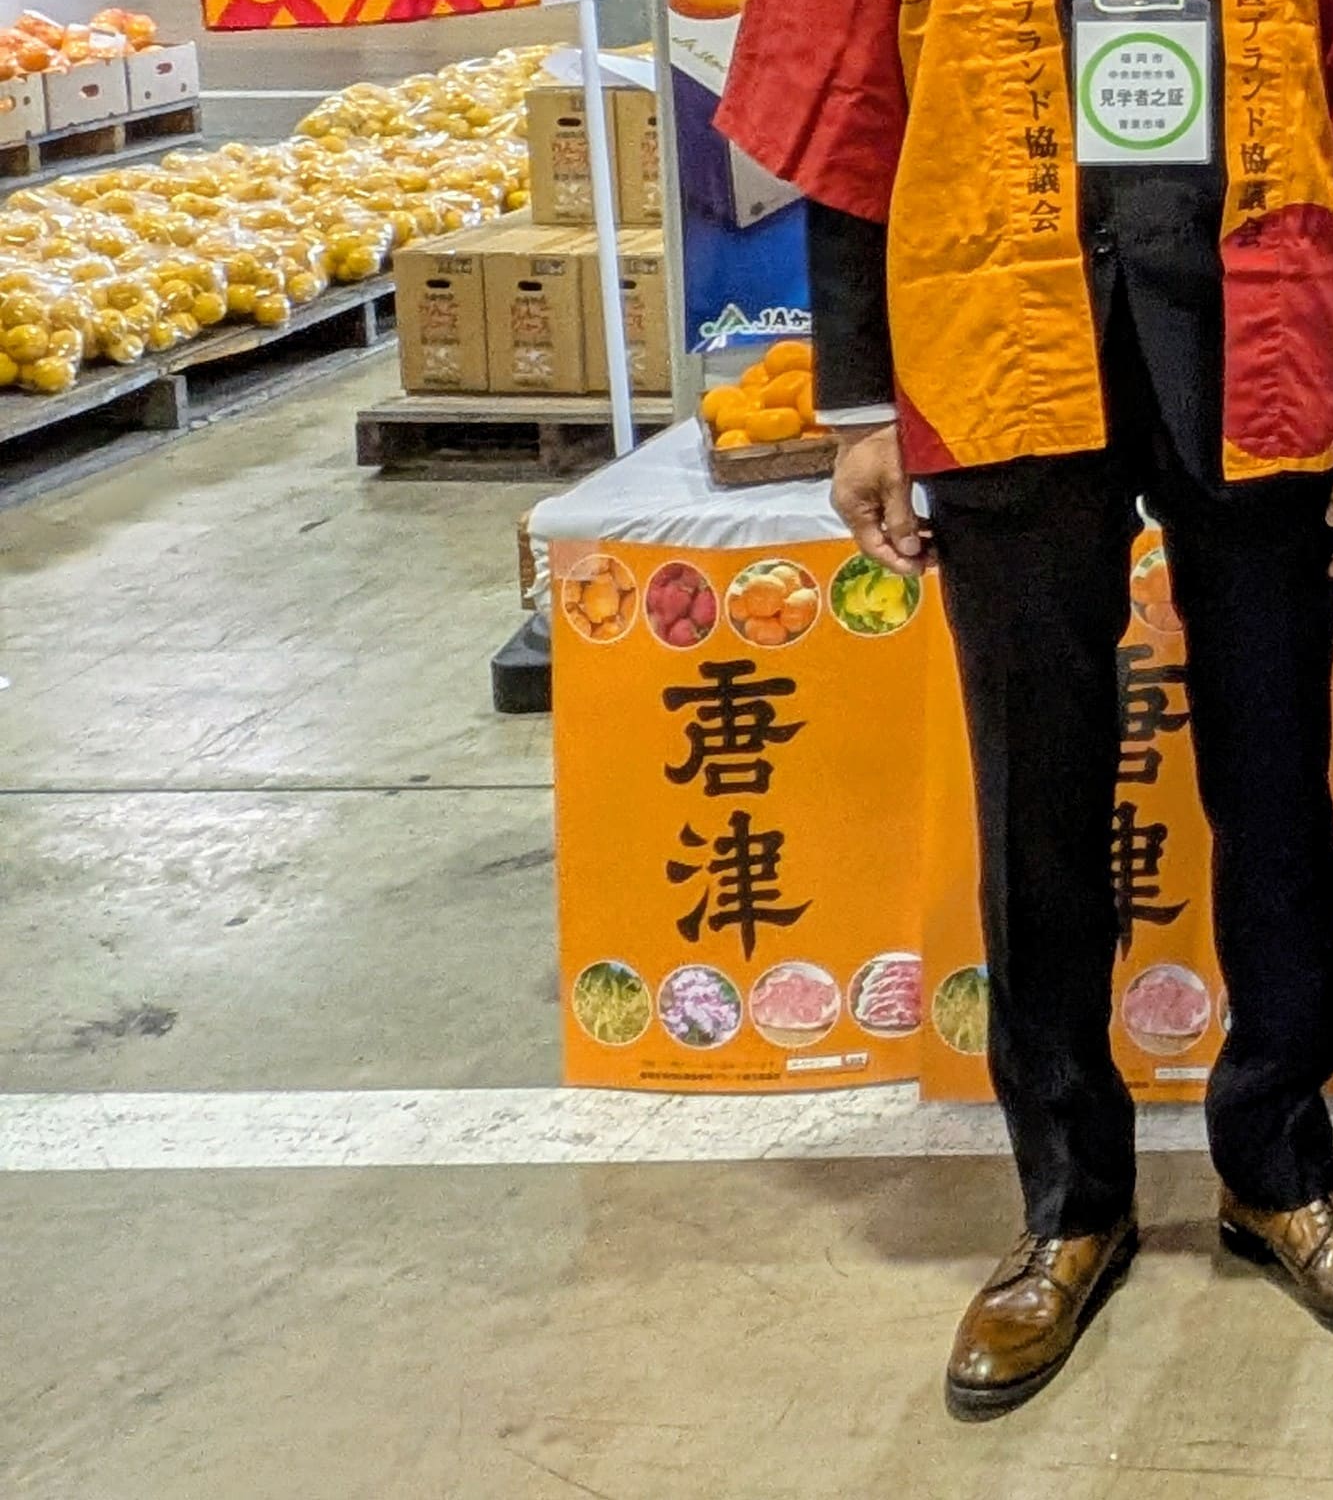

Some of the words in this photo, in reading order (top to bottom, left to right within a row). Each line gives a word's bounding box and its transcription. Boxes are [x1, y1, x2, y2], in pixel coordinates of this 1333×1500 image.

[1099, 87, 1185, 107] 見学者之証
[662, 659, 813, 962] 唐津
